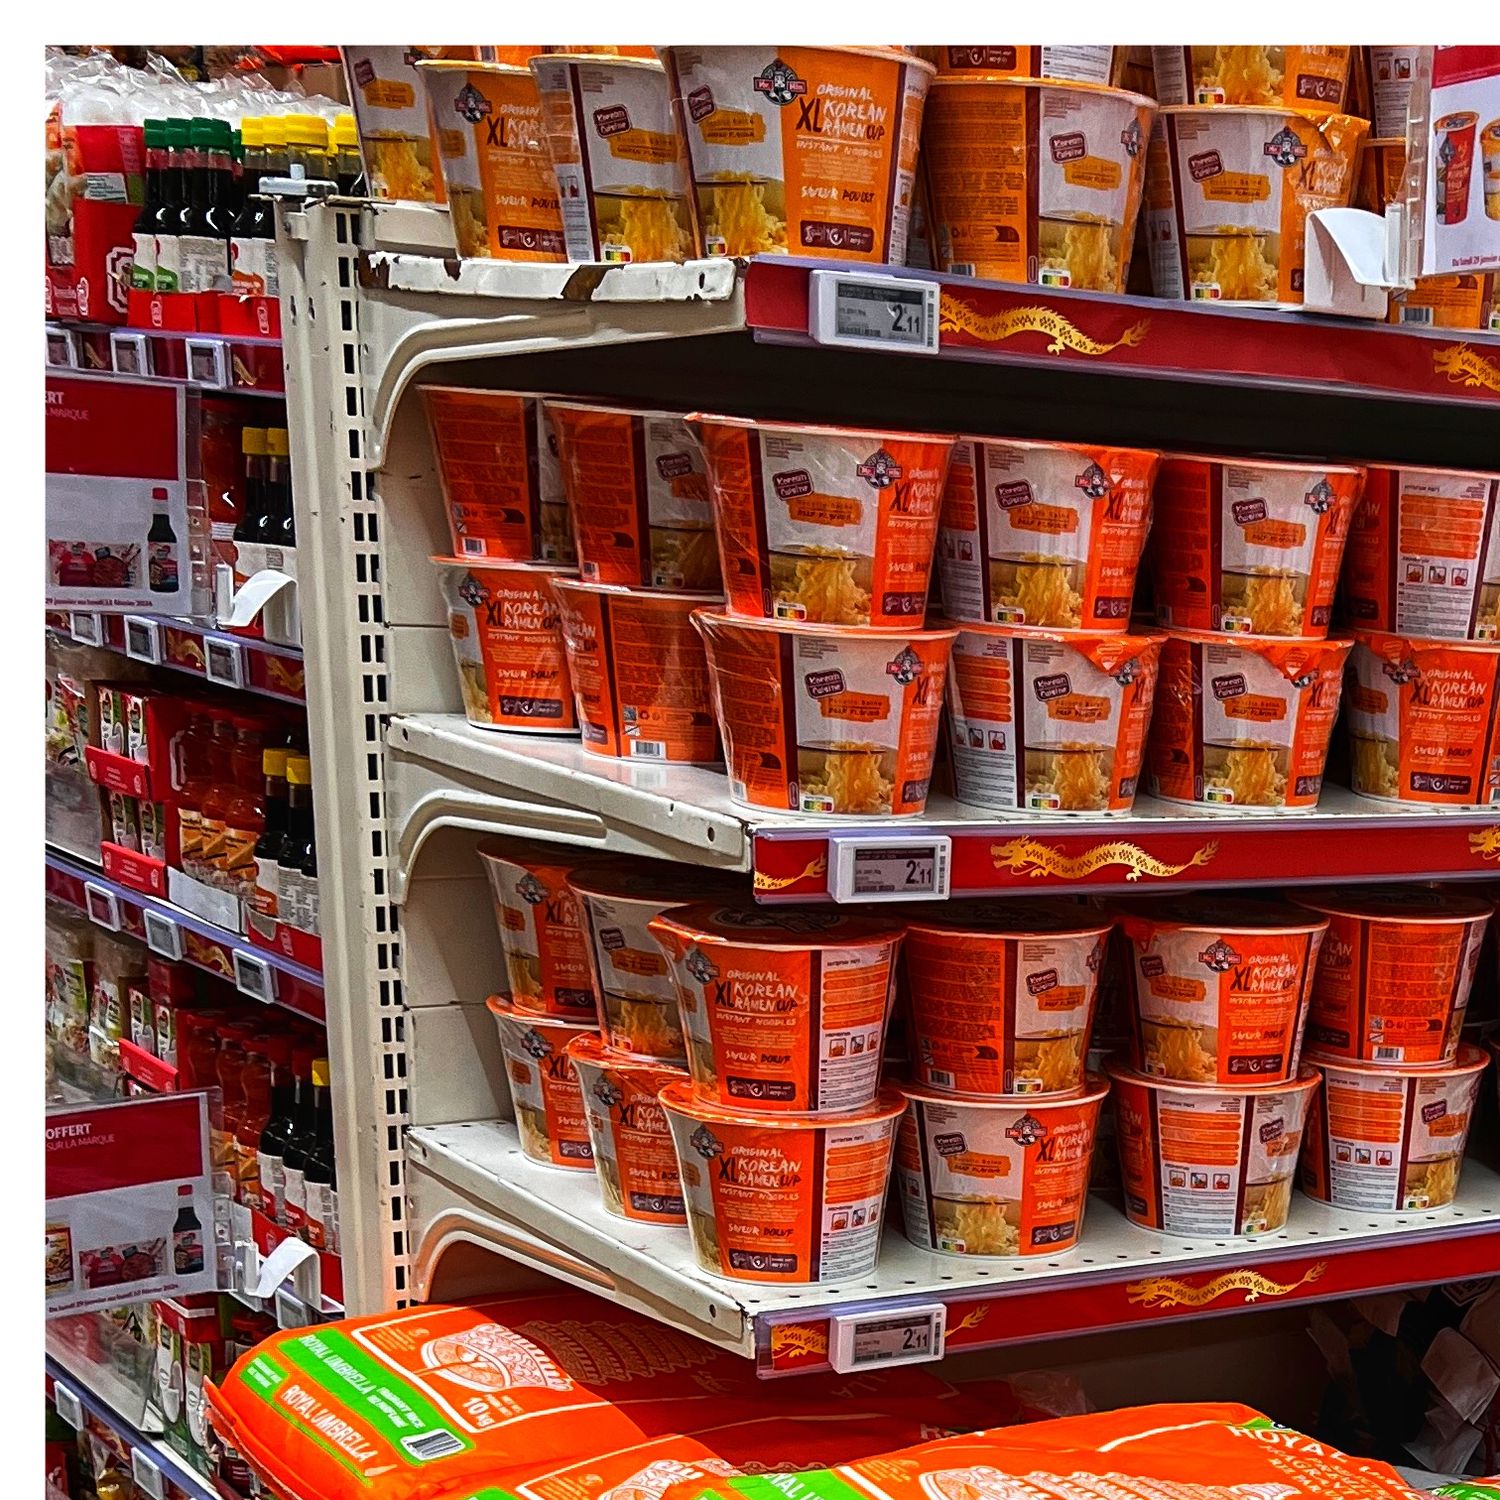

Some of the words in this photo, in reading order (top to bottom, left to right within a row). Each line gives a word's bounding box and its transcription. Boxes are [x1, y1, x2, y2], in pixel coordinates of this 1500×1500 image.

[822, 99, 886, 121] KOREAN
[1431, 680, 1487, 695] KOREAN
[727, 969, 780, 982] ORIGINAL
[715, 980, 734, 1008] XL
[734, 982, 798, 998] KOREAN
[46, 1123, 92, 1140] OFFERT
[78, 1134, 115, 1147] MARQUE
[731, 1147, 784, 1159] ORIGINAL
[719, 1156, 739, 1184] XL
[737, 1158, 802, 1176] KOREAN
[280, 1385, 317, 1423] ROYAL
[310, 1408, 376, 1462] UMBRELLA
